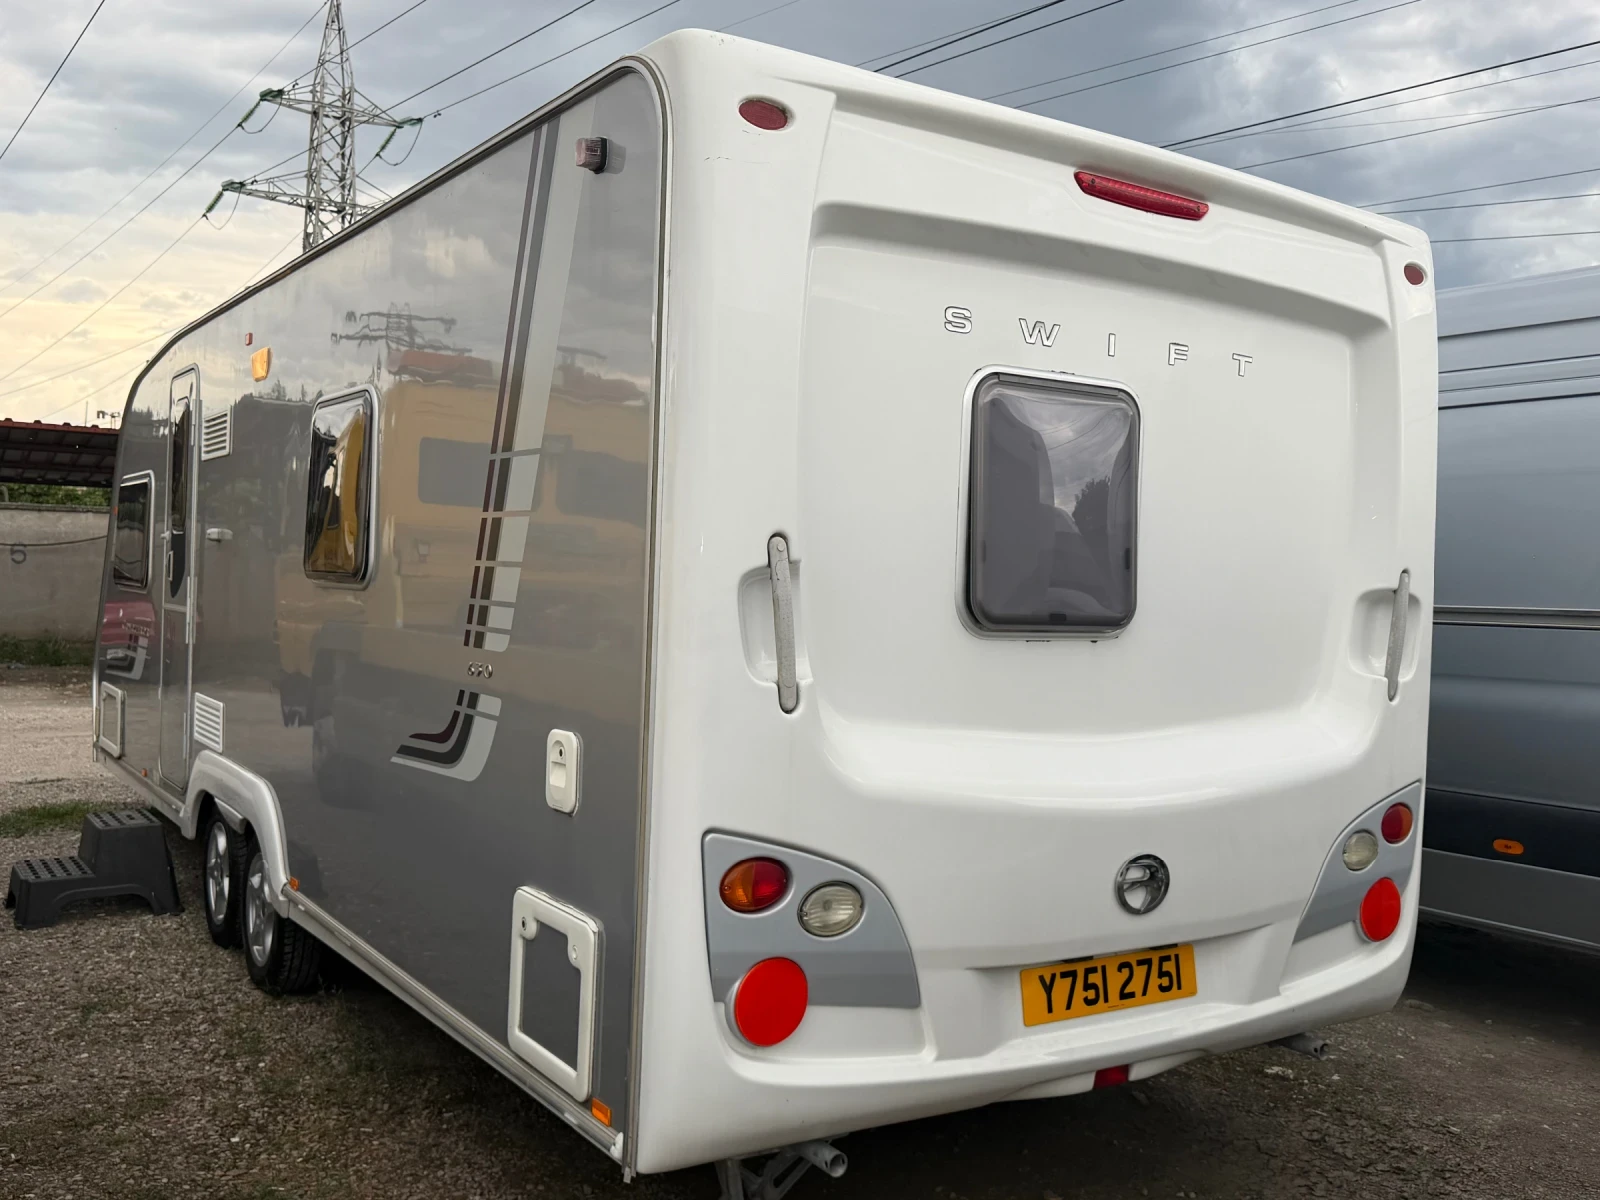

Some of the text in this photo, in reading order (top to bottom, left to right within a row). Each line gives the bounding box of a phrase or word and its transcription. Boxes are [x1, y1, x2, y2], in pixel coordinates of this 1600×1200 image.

[944, 305, 1253, 377] SWIFT
[1038, 953, 1182, 1014] Y751 2751
